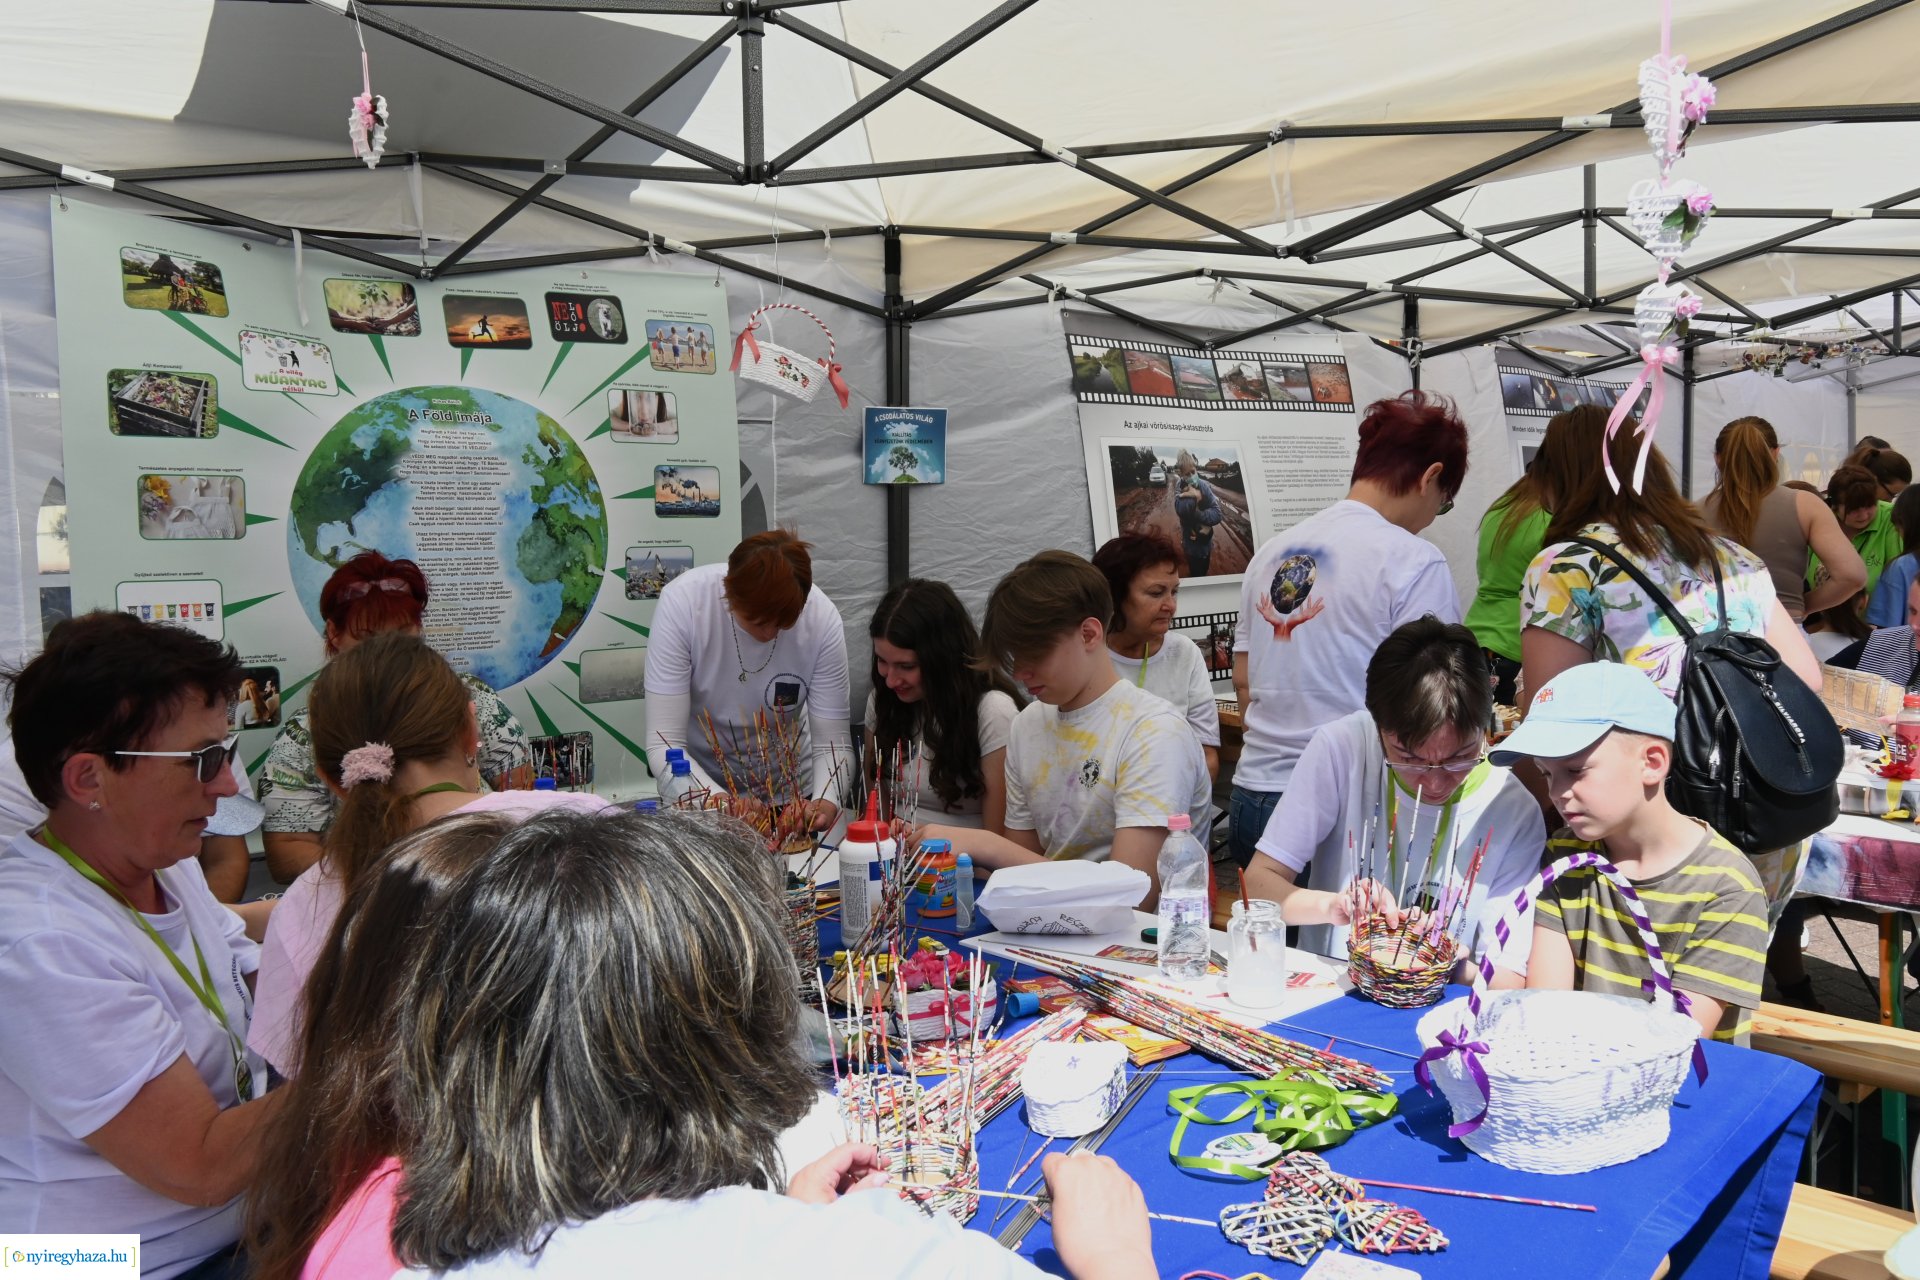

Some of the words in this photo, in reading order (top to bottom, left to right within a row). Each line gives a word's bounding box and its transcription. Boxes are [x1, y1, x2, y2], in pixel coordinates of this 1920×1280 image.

[255, 371, 328, 389] MŰANYAG
[409, 409, 420, 420] A
[422, 409, 452, 421] Föld
[456, 412, 492, 425] imája
[879, 411, 914, 421] CSODÁLATOS
[915, 413, 934, 424] VILÁG
[1124, 420, 1133, 428] Az
[1134, 421, 1148, 430] ajkai
[1150, 422, 1214, 433] vörösiszap-katasztrófa
